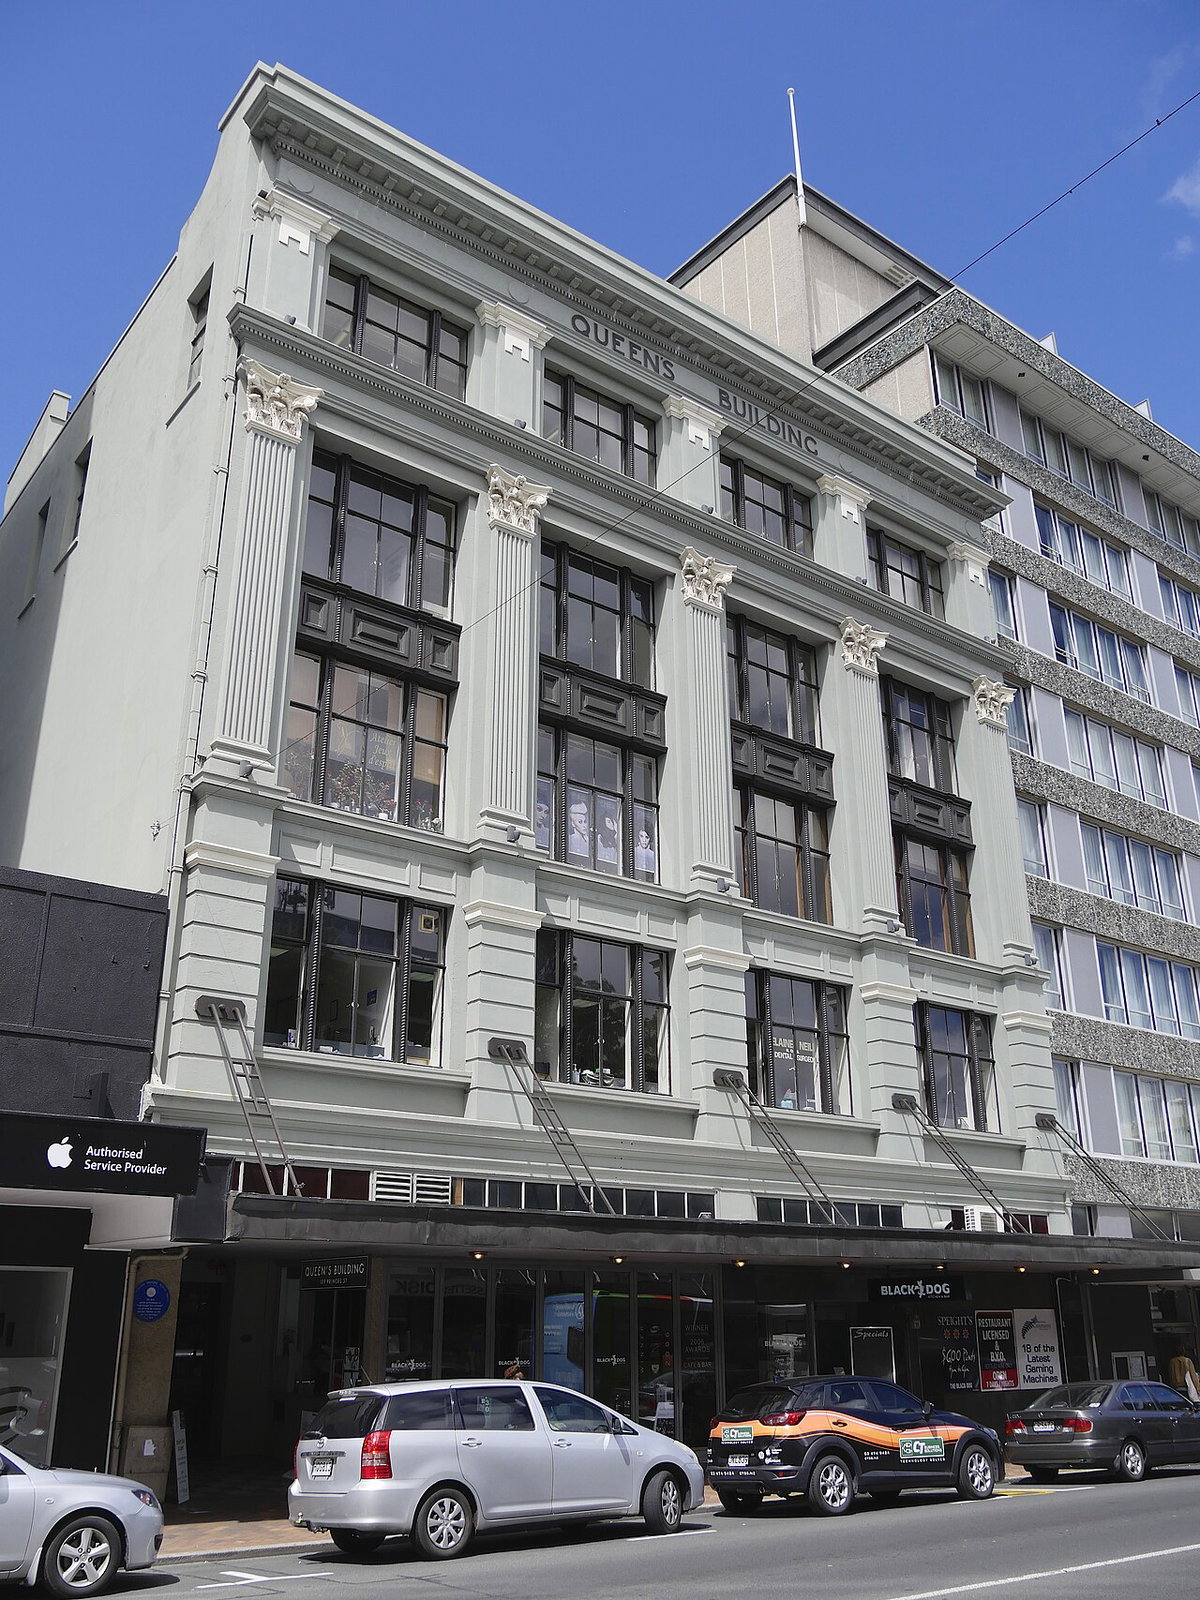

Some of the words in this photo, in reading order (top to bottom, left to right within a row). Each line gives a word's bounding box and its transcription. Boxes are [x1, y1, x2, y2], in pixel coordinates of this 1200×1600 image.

[571, 314, 676, 381] QUEEN'S
[718, 388, 819, 456] BUILDING
[370, 733, 397, 746] Atelier
[774, 1051, 794, 1060] DENTAL
[85, 1145, 143, 1159] Authorised
[83, 1159, 122, 1172] Service
[124, 1162, 168, 1175] Provider
[304, 1265, 332, 1277] QUEEN'S
[333, 1262, 365, 1275] BUILDING
[880, 1284, 915, 1296] BLACK
[925, 1283, 951, 1295] DOG
[936, 1316, 974, 1327] SPEIGHT'S
[978, 1318, 1011, 1328] RESTAURANT
[684, 1324, 709, 1332] WINNER
[853, 1328, 889, 1340] Specials
[982, 1329, 1010, 1341] LICENSED
[684, 1345, 711, 1353] AWARDS
[994, 1340, 1000, 1351] &
[1022, 1343, 1032, 1353] 18
[1033, 1343, 1042, 1353] of
[1042, 1343, 1055, 1353] the
[1027, 1354, 1050, 1363] Latest
[1026, 1364, 1054, 1374] Gaming
[992, 1370, 1008, 1381] OPEN
[1022, 1374, 1058, 1384] Machines
[729, 1428, 739, 1439] CT
[912, 1440, 926, 1454] CT
